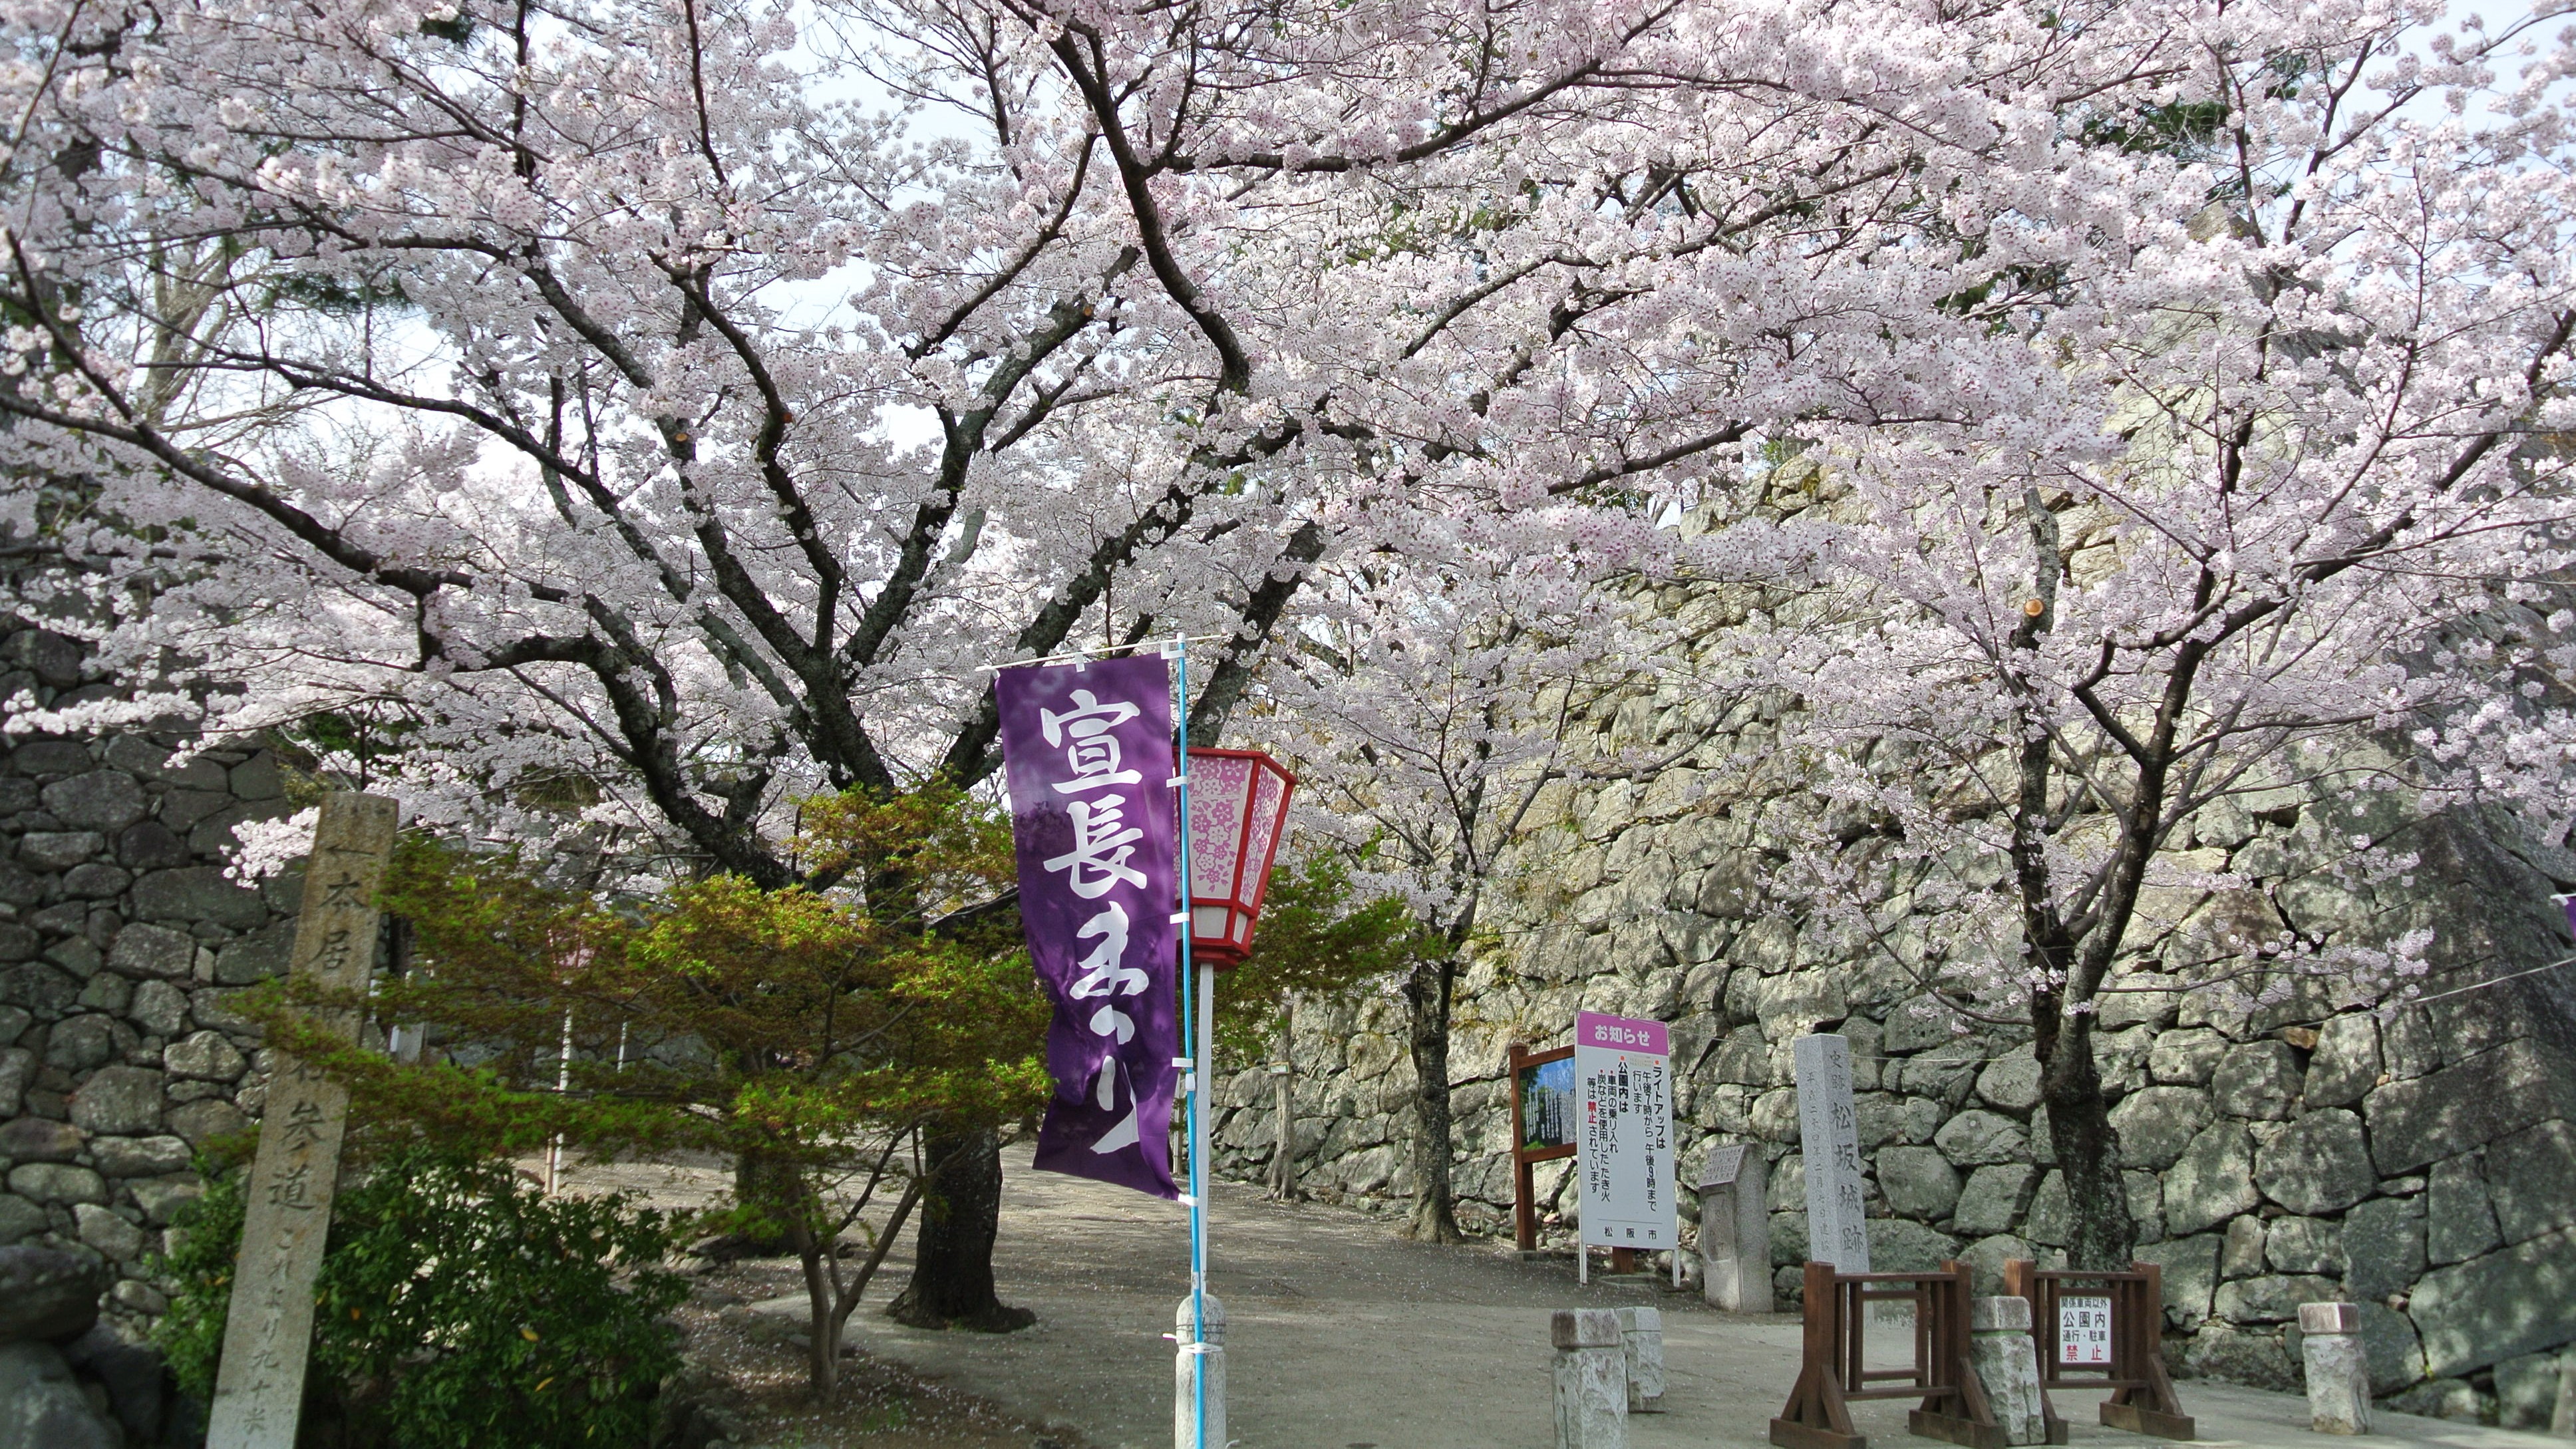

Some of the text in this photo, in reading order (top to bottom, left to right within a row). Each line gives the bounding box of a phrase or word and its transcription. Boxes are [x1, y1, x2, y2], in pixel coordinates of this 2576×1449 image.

[1041, 689, 1149, 1154] 宣長まつり
[1595, 1025, 1650, 1046] お知らせ
[1618, 1062, 1629, 1113] 公園内は
[1633, 1070, 1642, 1114] 行います
[1653, 1066, 1666, 1149] ライトアップは
[1587, 1077, 1599, 1193] 等は禁止されています
[1607, 1074, 1619, 1153] 車両の乗り入れ
[1597, 1074, 1610, 1202] 炭などを使用したたき火
[1643, 1071, 1657, 1211] 午後7時から 午後9時まで
[1605, 1226, 1657, 1239] 松阪市
[2061, 1298, 2108, 1308] 関係車両以外
[2063, 1311, 2106, 1327] 公園内
[2063, 1330, 2106, 1342] 通行・駐車
[2066, 1345, 2102, 1361] 禁止
